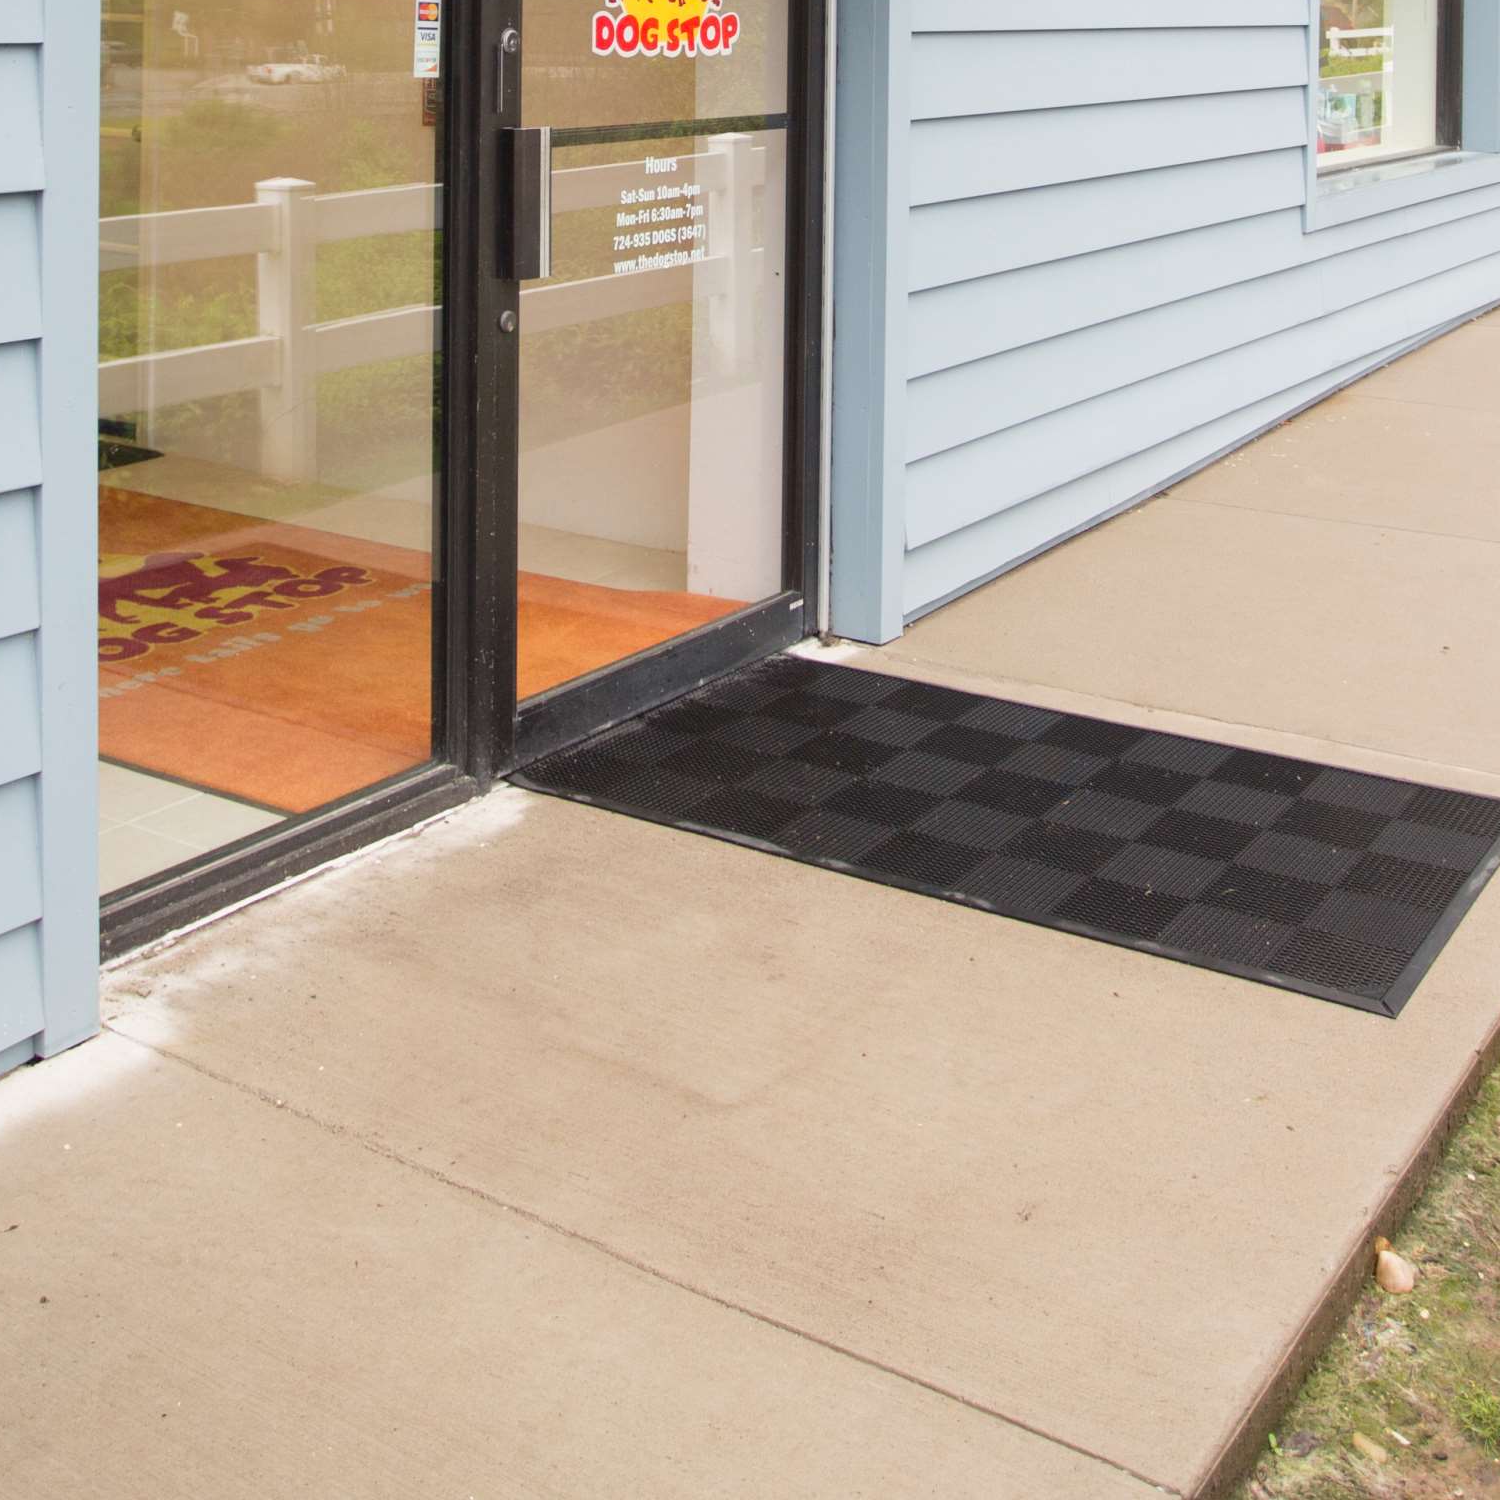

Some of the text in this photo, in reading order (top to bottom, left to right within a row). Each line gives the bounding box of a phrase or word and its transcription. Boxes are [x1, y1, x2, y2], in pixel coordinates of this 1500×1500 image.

[420, 32, 436, 41] VISA
[596, 14, 739, 52] DOG STOP
[644, 156, 677, 174] Hours
[620, 182, 701, 204] Sat-Sun 10am-4pm
[616, 203, 704, 227] Mon-Fri 6:30am-7pm
[613, 223, 706, 251] 724-935 DOGS (3647)
[613, 245, 705, 274] www.thedogstop.net
[98, 565, 374, 662] OG STOP
